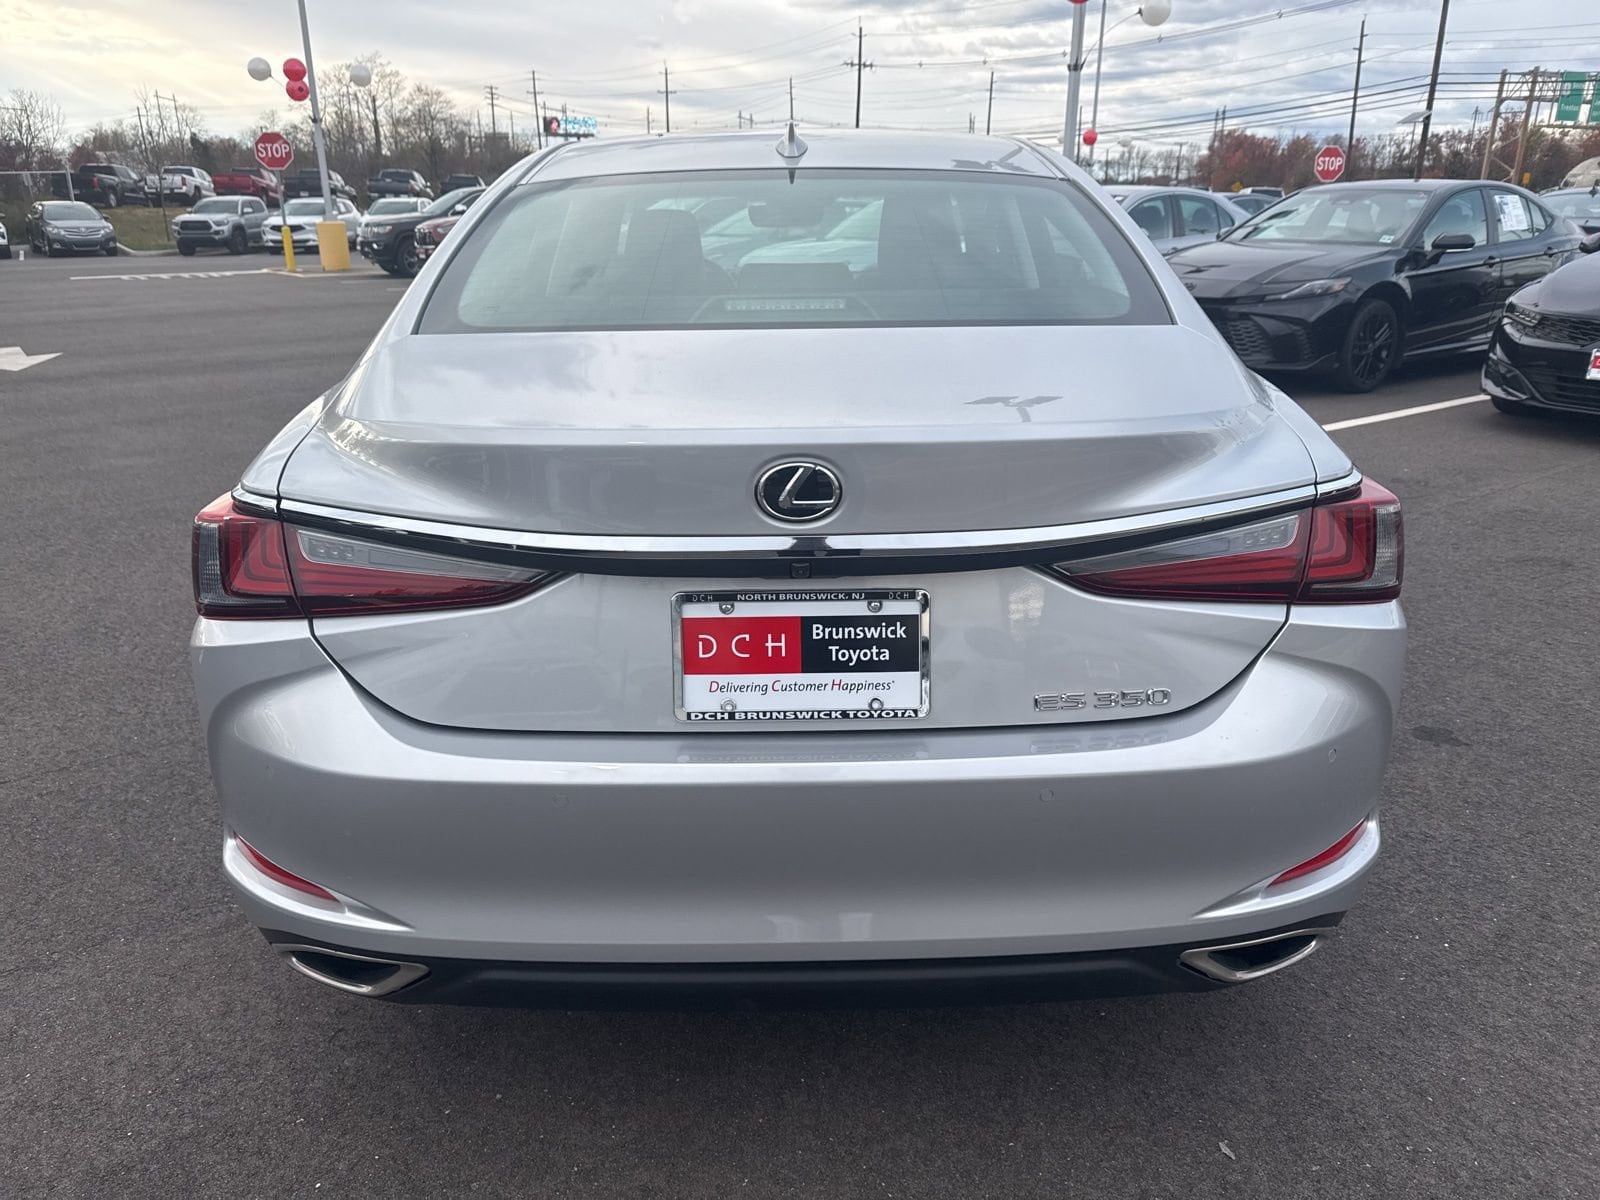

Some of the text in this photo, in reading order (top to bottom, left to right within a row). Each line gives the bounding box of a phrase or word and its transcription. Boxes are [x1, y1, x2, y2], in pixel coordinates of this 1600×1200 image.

[257, 143, 290, 158] STOP
[1317, 156, 1343, 171] STOP
[737, 593, 776, 601] NORTH
[851, 592, 865, 600] NJ
[812, 623, 907, 640] Brunswick
[829, 646, 890, 665] Toyota
[709, 680, 768, 695] Delivering
[771, 679, 828, 693] Customer
[1034, 687, 1172, 711] ES 350
[690, 709, 916, 720] DCH BRUNSWICK TOYOTA
